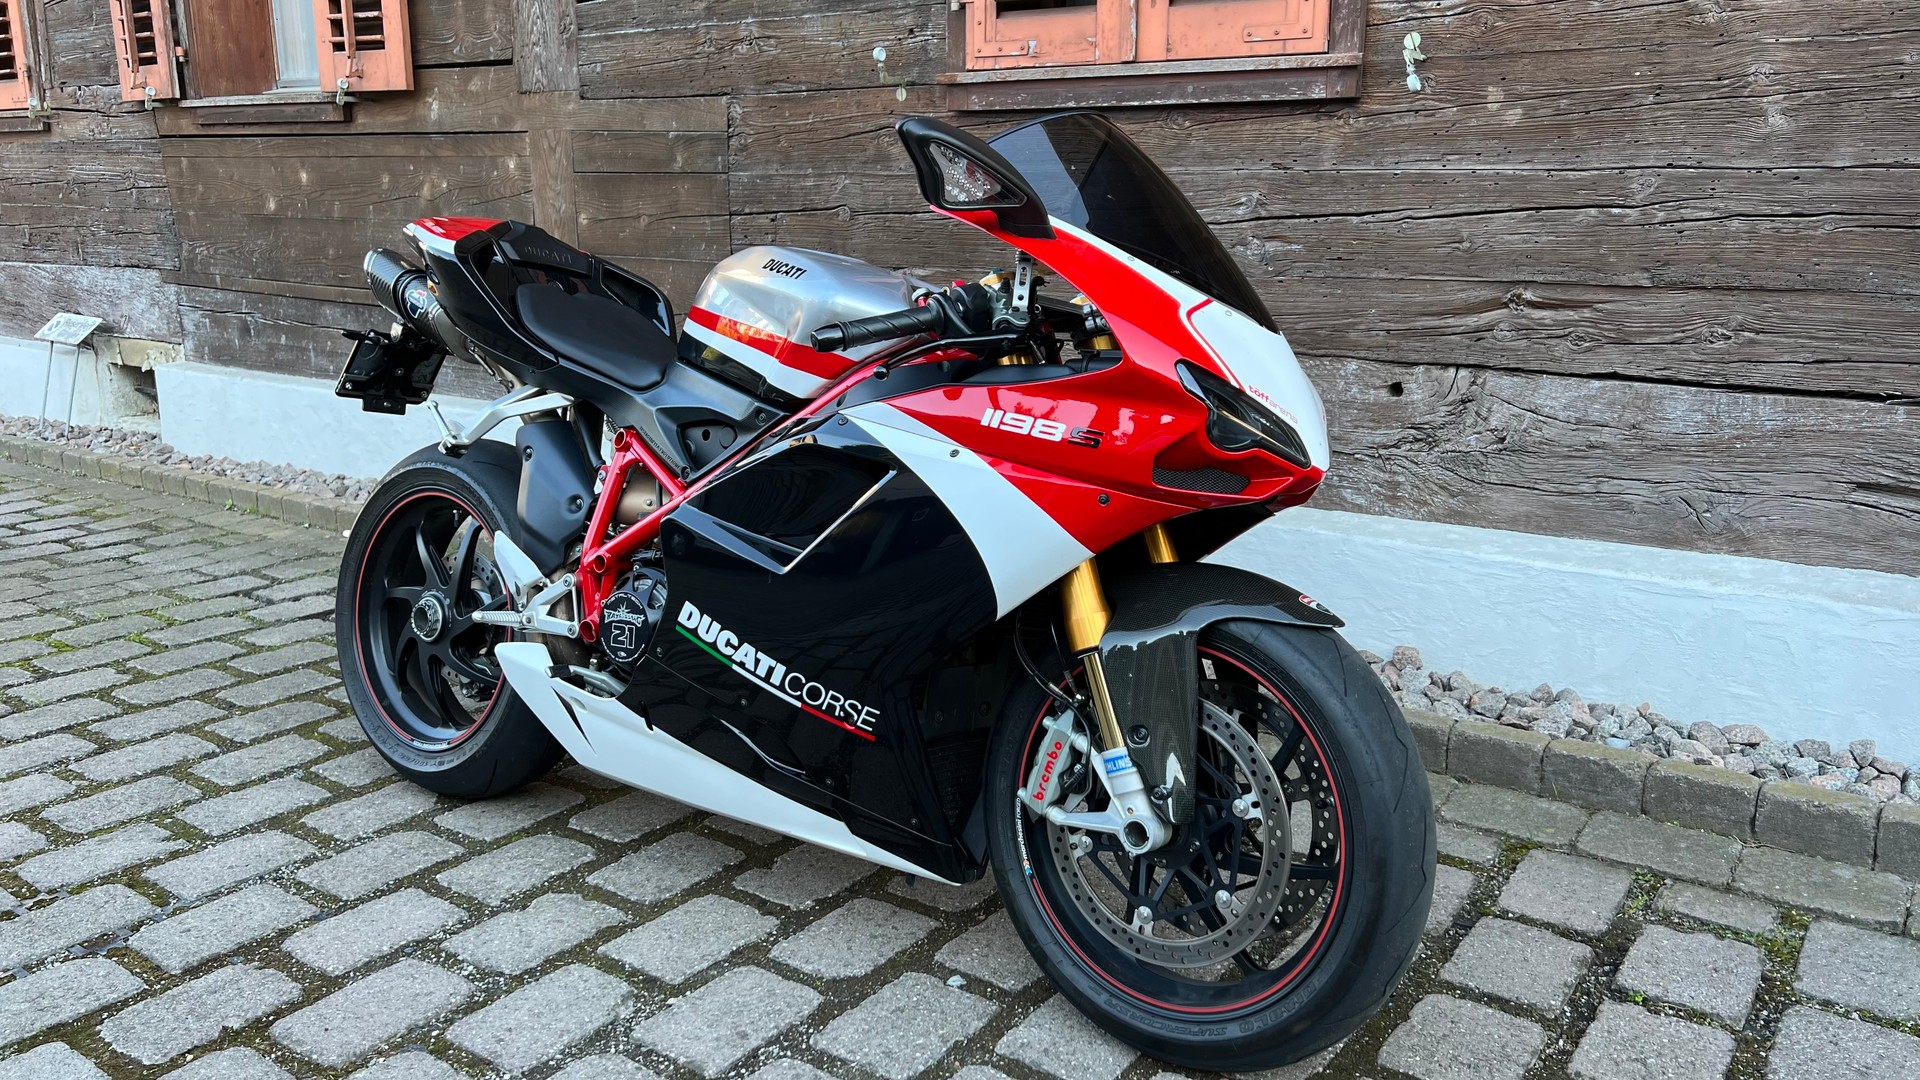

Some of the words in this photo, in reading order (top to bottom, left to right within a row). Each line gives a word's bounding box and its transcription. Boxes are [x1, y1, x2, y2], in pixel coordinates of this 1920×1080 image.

[762, 258, 808, 279] DUCATI
[1248, 385, 1298, 425] töffarena
[980, 407, 1067, 442] 1198
[1067, 427, 1105, 449] S
[610, 622, 636, 649] 21
[677, 600, 787, 686] DUCATI
[784, 672, 880, 731] CORSE
[1032, 741, 1063, 801] brembo
